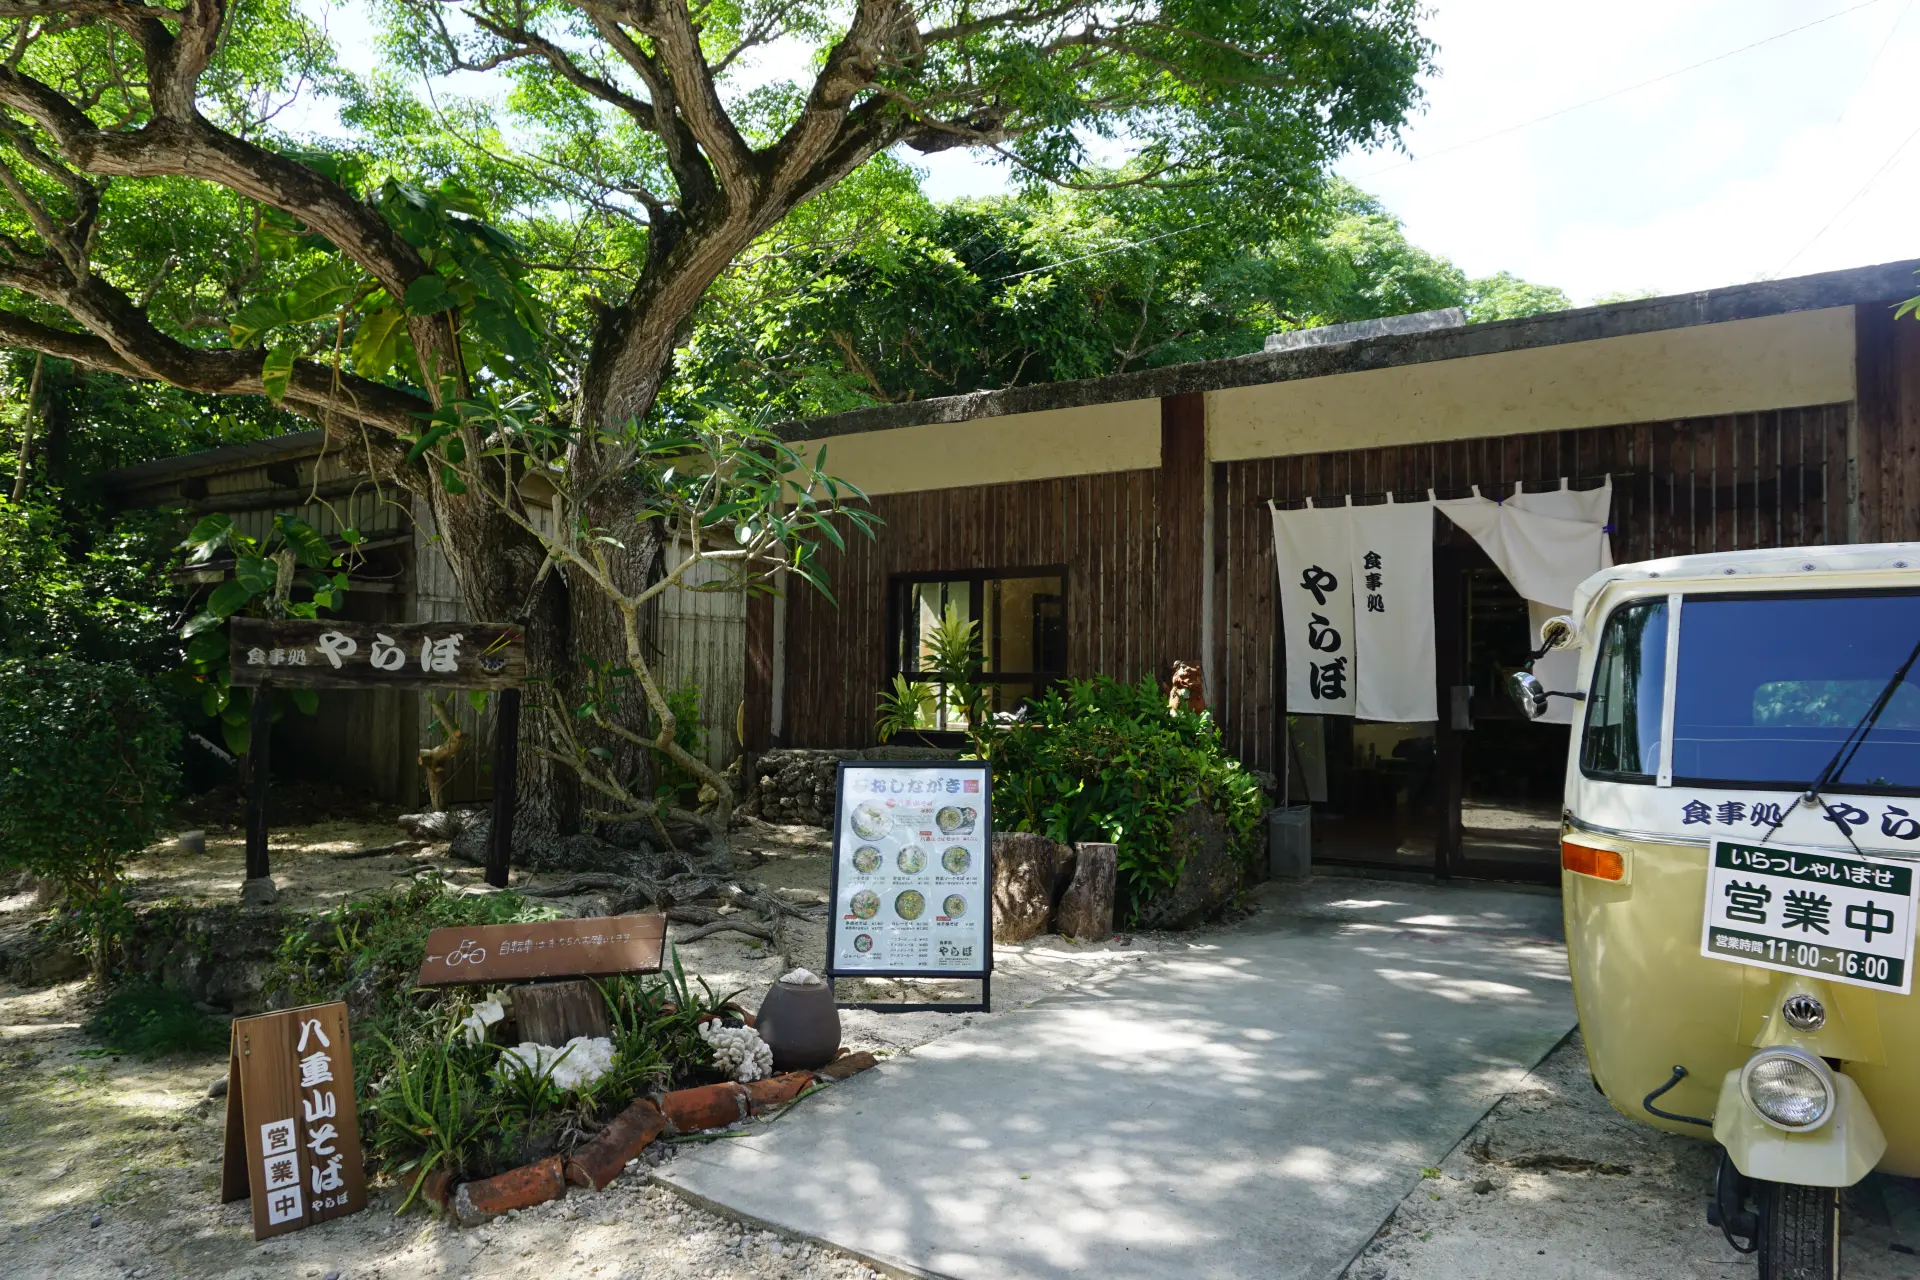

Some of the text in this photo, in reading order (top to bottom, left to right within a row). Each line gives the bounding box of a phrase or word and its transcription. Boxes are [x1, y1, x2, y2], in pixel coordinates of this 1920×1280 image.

[1363, 550, 1385, 613] 食事処
[246, 630, 464, 672] 食事処 やらぼ
[1300, 564, 1348, 700] やらぼ
[871, 778, 961, 794] おしながき
[1681, 799, 1783, 828] 食事処
[1731, 848, 1894, 888] いらっしゃいませ
[1724, 879, 1894, 943] 営業中
[1715, 934, 1763, 954] 営業時間
[297, 1018, 344, 1194] 八重山そば
[267, 1125, 296, 1217] 営業中
[311, 1191, 349, 1212] やらぼ
